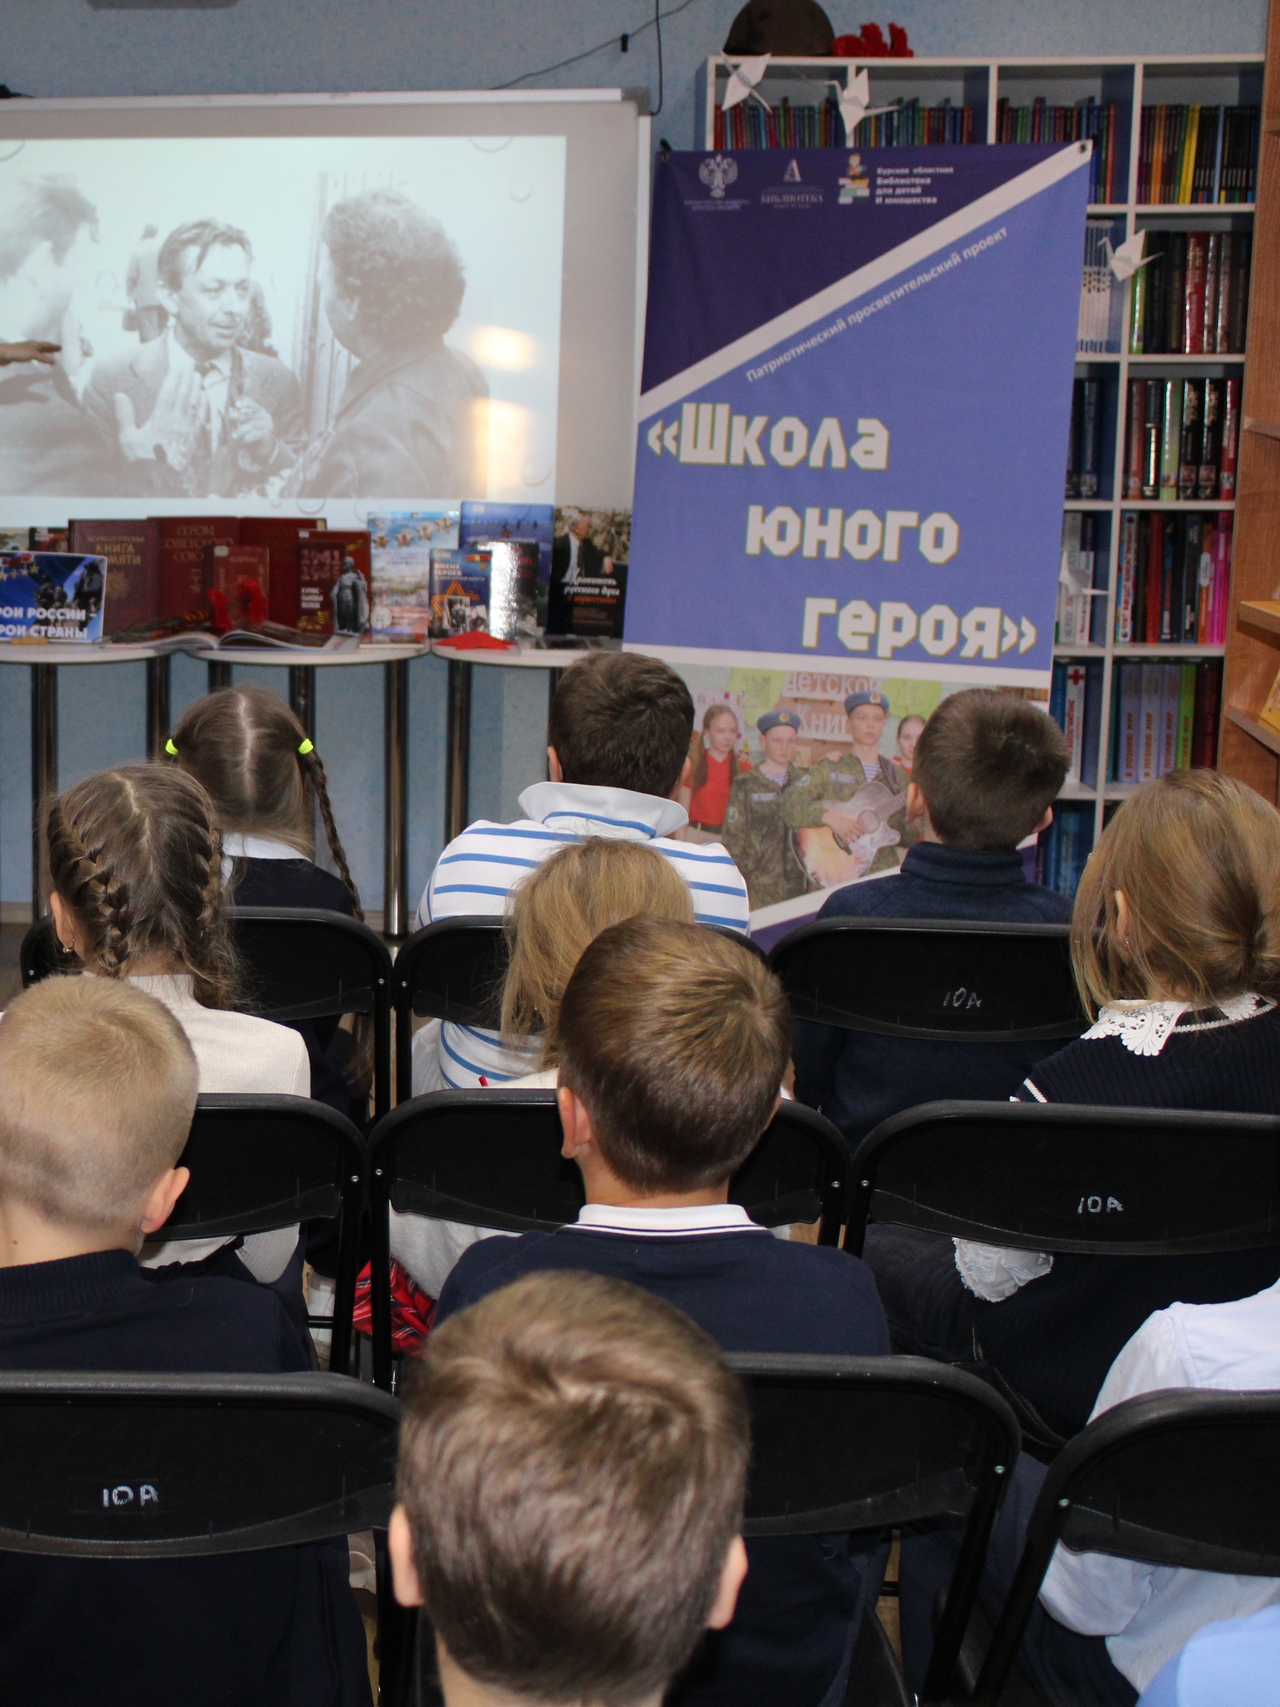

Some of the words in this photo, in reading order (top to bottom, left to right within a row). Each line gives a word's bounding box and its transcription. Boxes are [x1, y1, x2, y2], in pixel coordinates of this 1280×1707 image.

[877, 166, 910, 175] Курская
[912, 166, 954, 174] областная
[876, 176, 932, 185] Библиотека
[876, 187, 893, 195] для
[895, 185, 922, 195] детей
[884, 196, 938, 204] юношества
[746, 318, 847, 383] Патриотический
[847, 252, 962, 325] просветительский
[962, 226, 1009, 260] проект
[647, 402, 890, 471] «Школа
[177, 525, 215, 537] ГЕРОИ
[746, 505, 960, 565] юного
[96, 543, 136, 554] КНИГА
[108, 553, 141, 565] МЯТИ
[173, 550, 205, 562] СОЮ
[26, 606, 86, 621] РОССИИ
[29, 625, 88, 639] СТРАНЫ
[802, 596, 1038, 660] героя»
